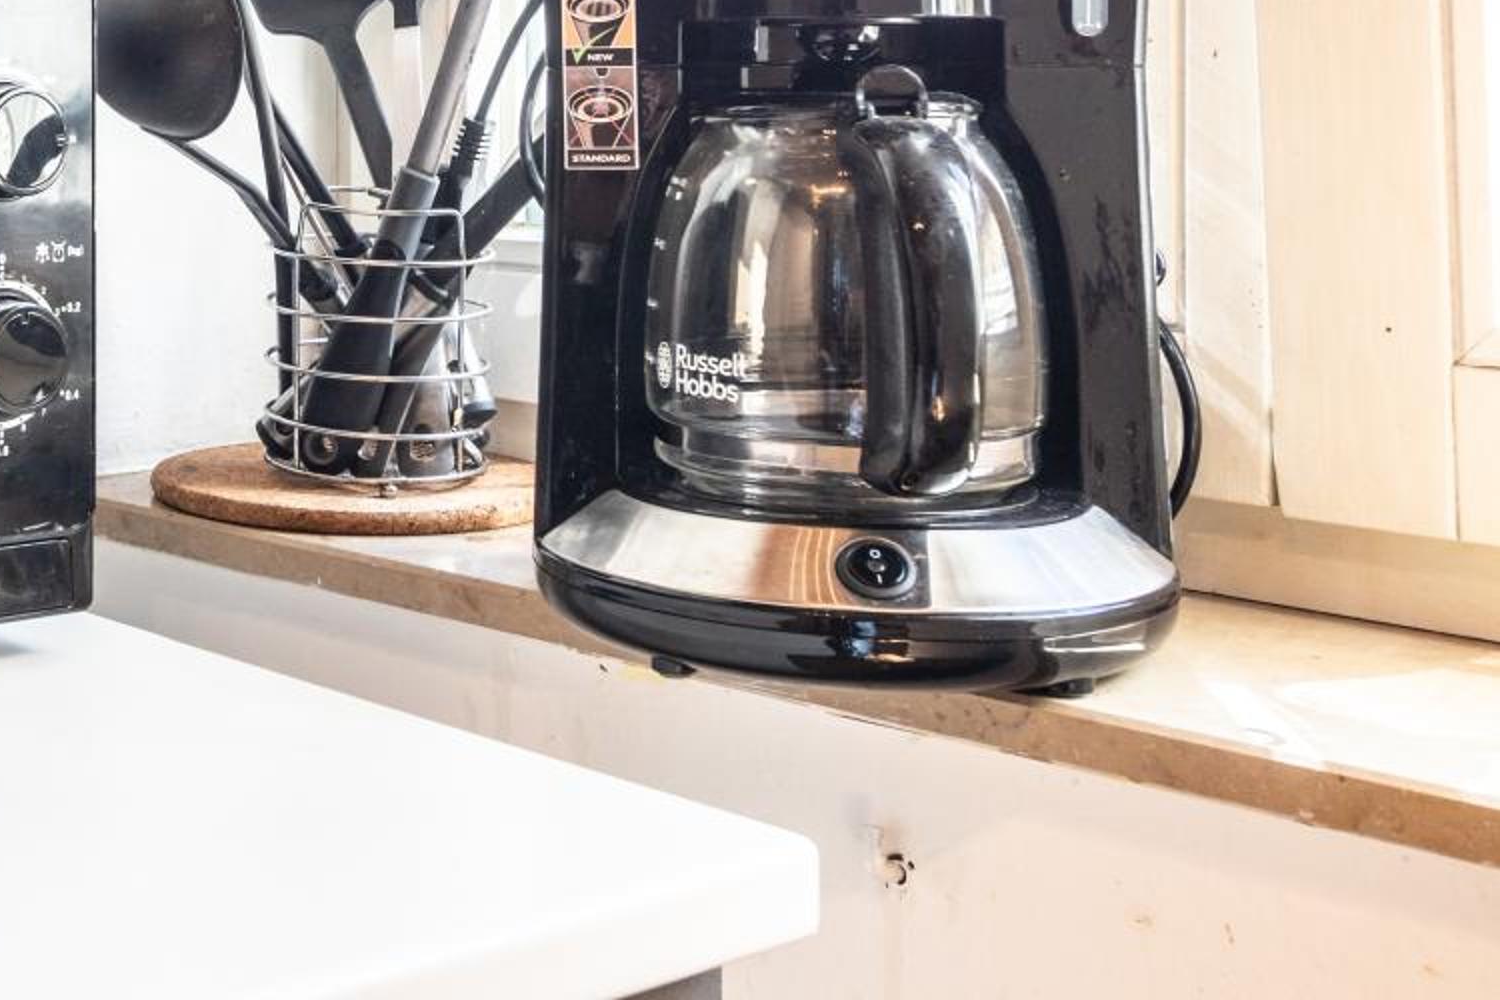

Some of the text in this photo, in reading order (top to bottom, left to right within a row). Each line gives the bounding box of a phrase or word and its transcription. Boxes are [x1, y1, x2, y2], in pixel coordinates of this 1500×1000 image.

[587, 53, 614, 62] NEW
[571, 154, 631, 164] STANDARD
[675, 344, 747, 380] Russell
[675, 370, 739, 403] Hobbs
